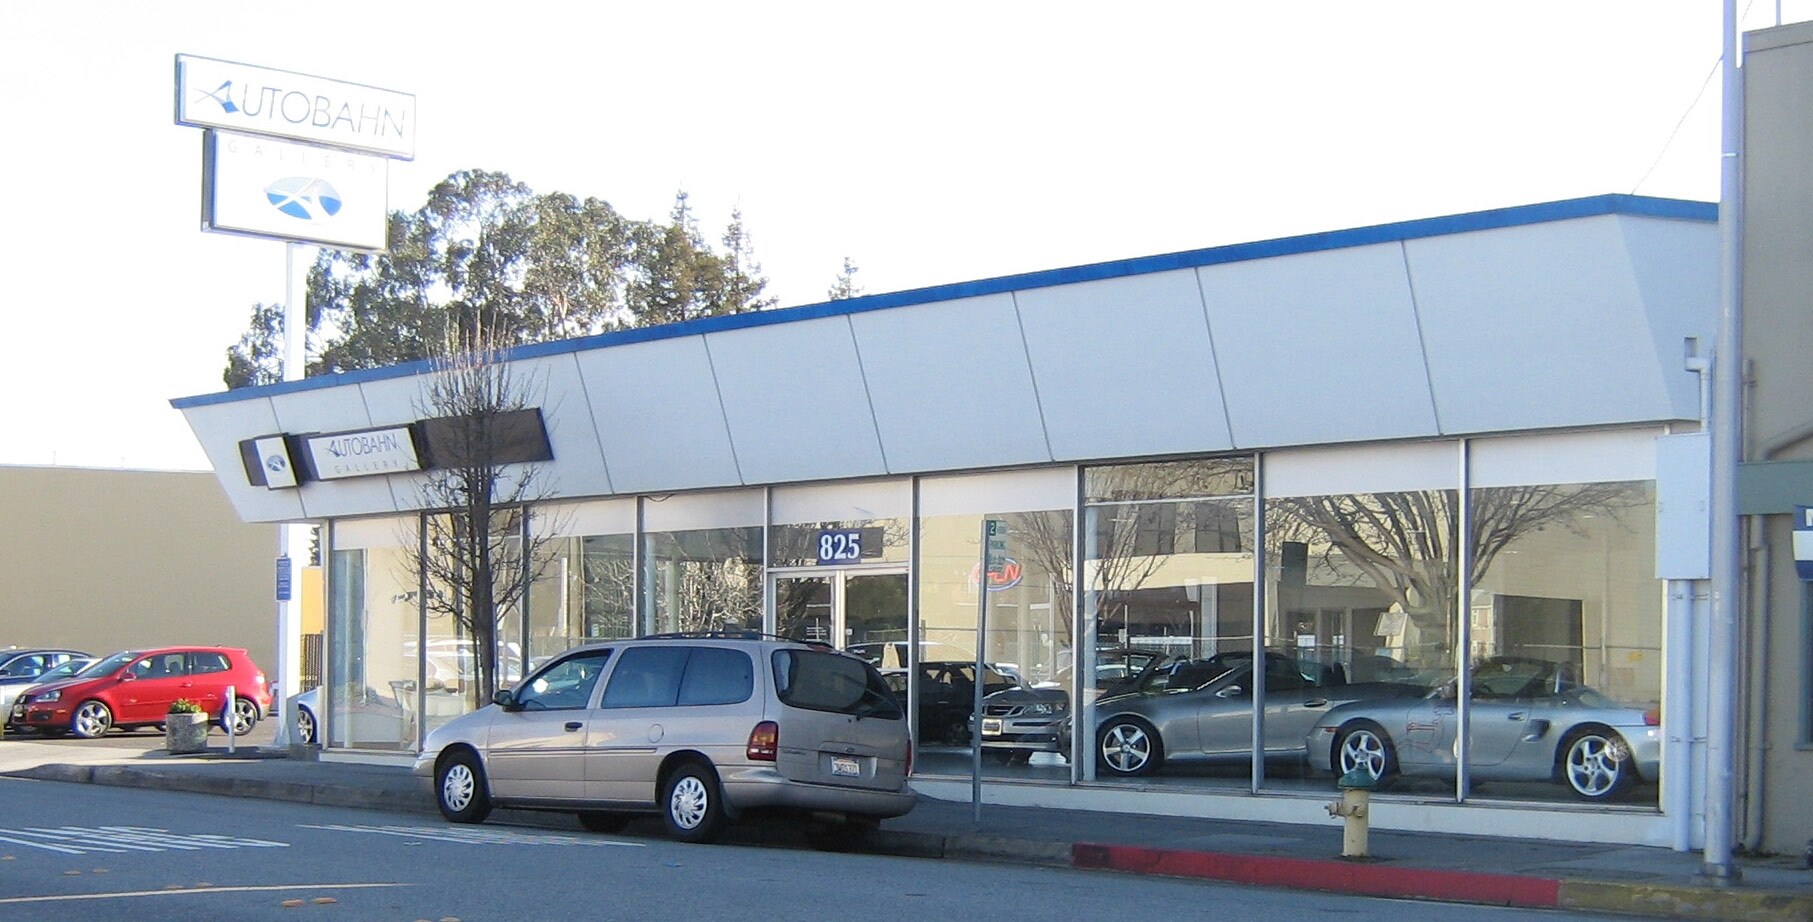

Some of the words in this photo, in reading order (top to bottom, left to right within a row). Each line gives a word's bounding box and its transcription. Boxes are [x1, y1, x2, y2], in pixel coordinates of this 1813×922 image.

[193, 79, 406, 139] AUTOBAHN
[227, 139, 378, 174] GALLERY
[325, 432, 398, 457] AUTOBAHN
[334, 460, 398, 474] GALLERY
[820, 533, 860, 560] 825
